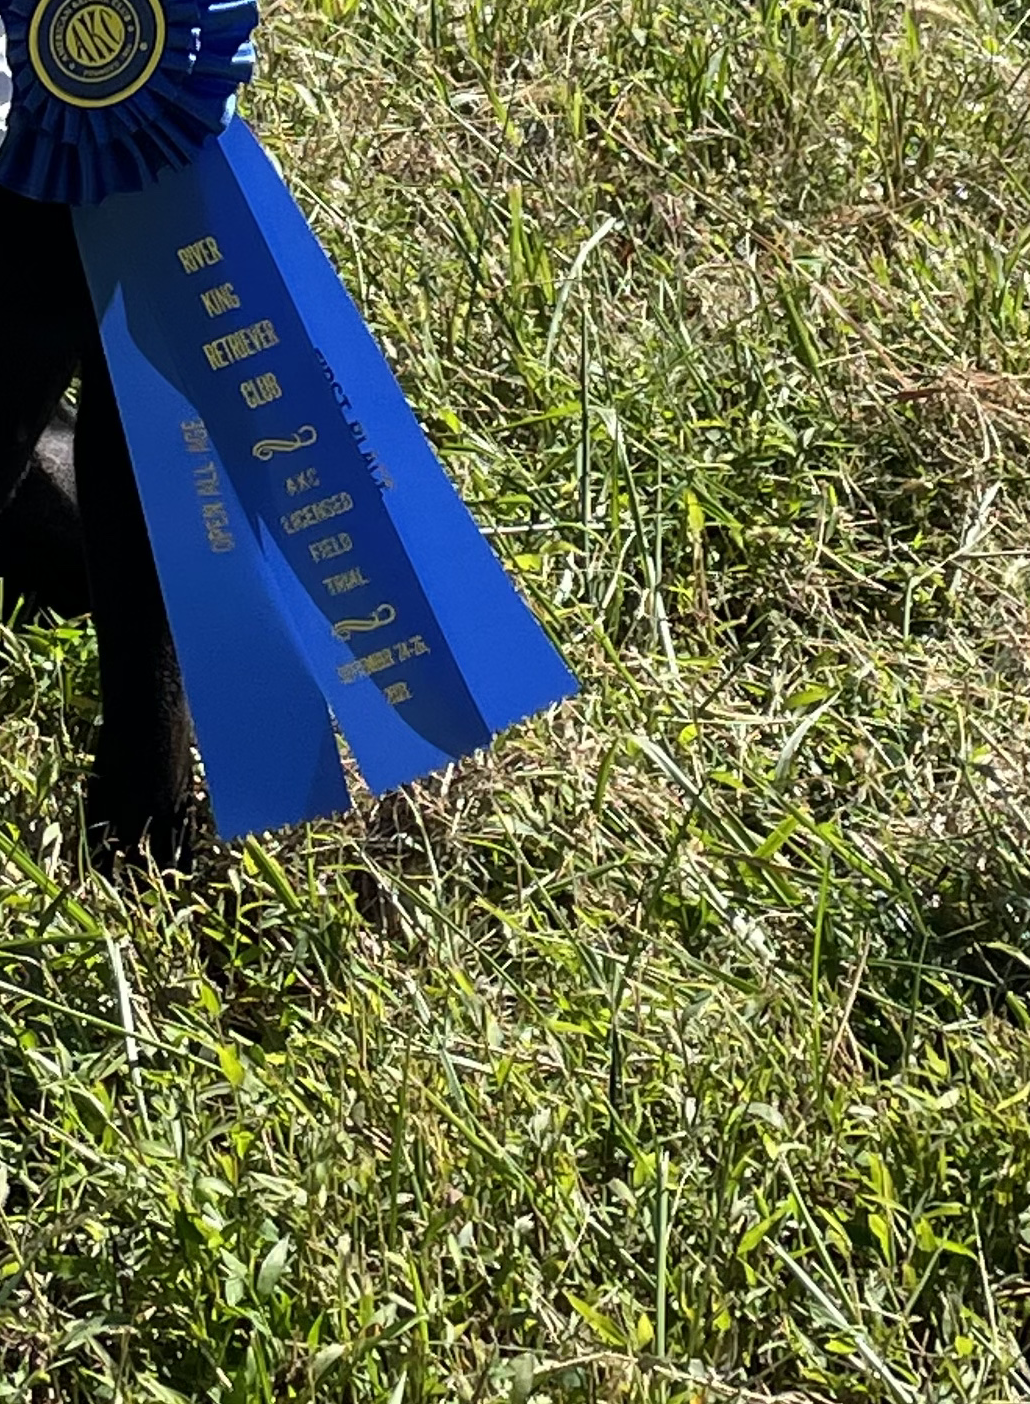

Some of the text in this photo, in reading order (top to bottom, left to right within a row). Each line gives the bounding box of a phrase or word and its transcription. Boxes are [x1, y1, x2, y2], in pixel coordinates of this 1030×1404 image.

[71, 8, 123, 63] AKC
[177, 236, 224, 275] RIVER
[200, 282, 241, 318] KING
[202, 319, 280, 370] RETRIEVER
[240, 372, 283, 409] CLUB
[285, 467, 320, 496] AKC
[279, 492, 353, 534] LICENSED
[308, 532, 353, 563] FIELD
[322, 566, 369, 596] TRIAL
